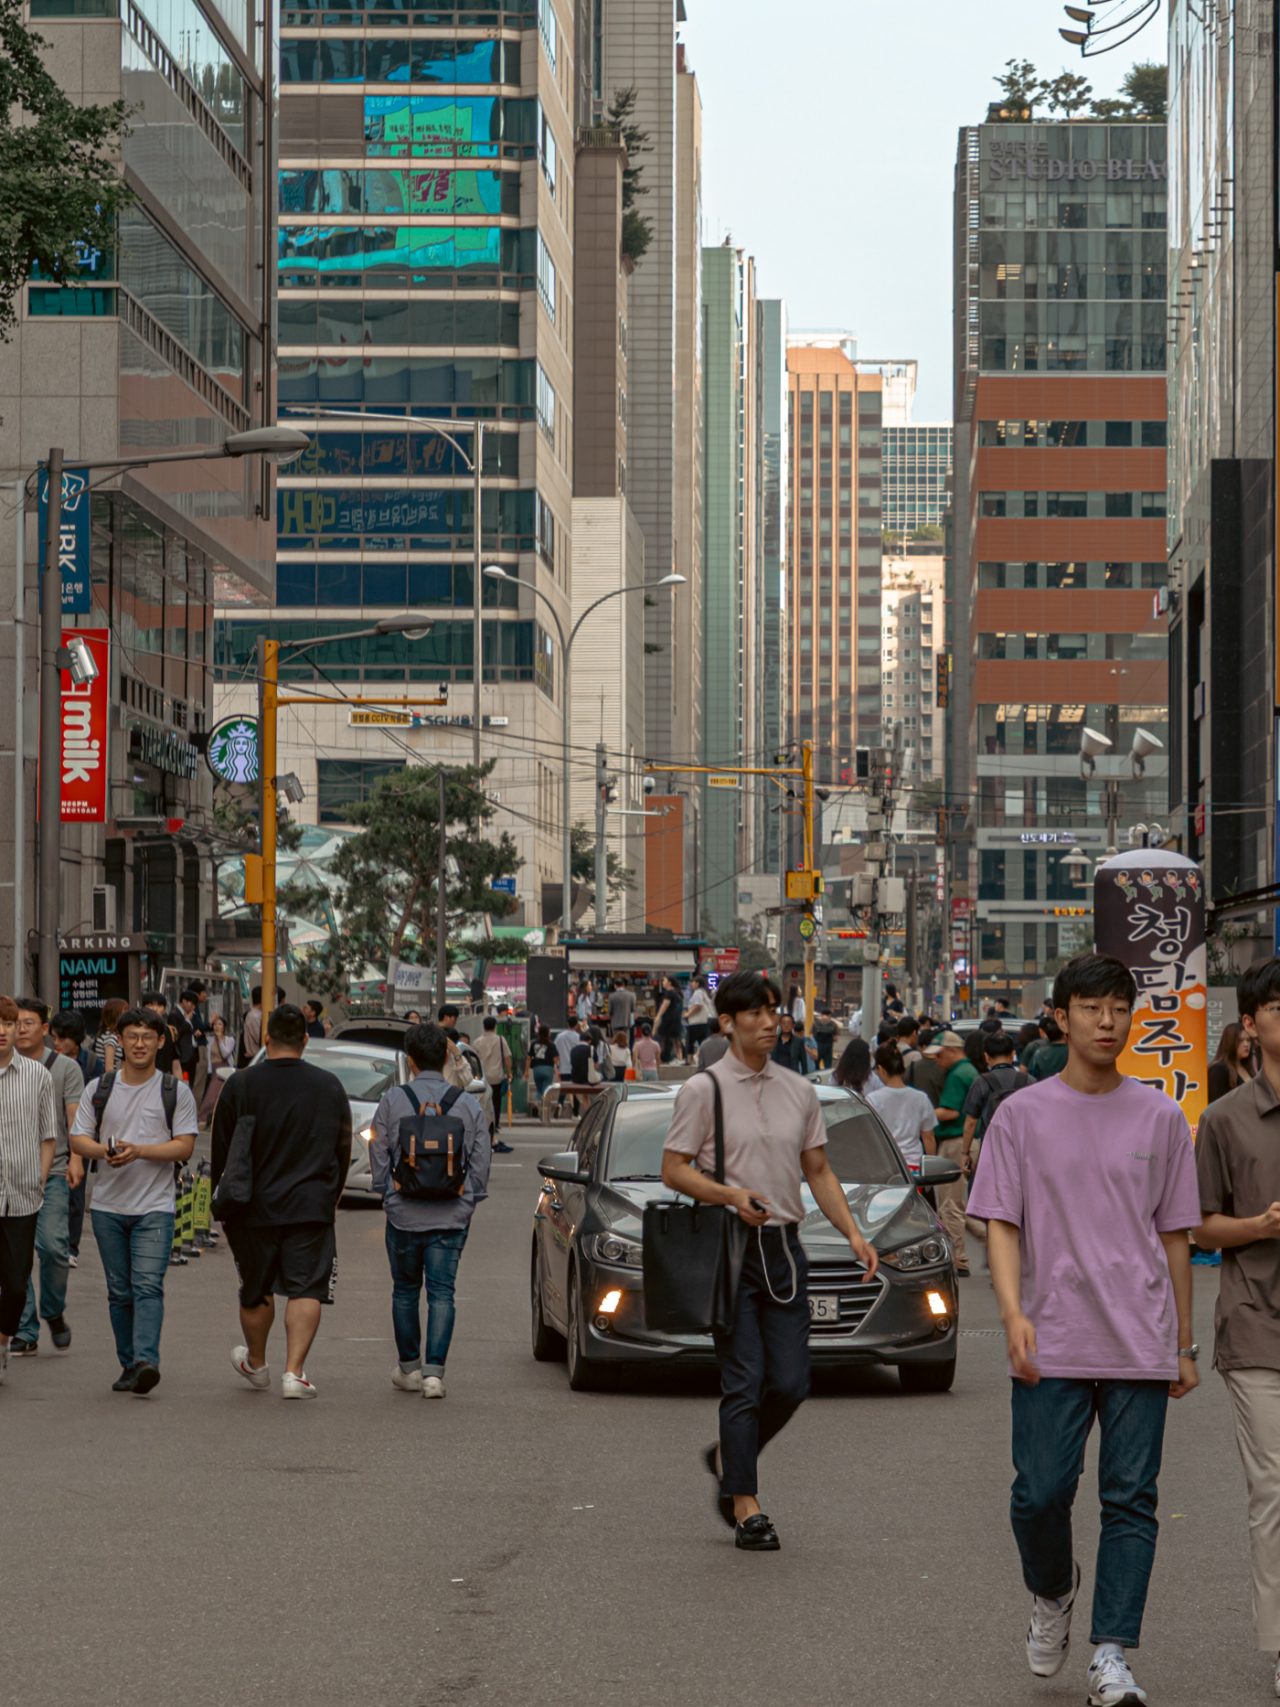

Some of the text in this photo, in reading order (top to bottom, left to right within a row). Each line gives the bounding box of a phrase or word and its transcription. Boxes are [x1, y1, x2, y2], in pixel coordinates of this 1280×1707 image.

[989, 157, 1100, 182] STUDIO
[62, 701, 100, 784] milk
[60, 958, 117, 976] NAMU
